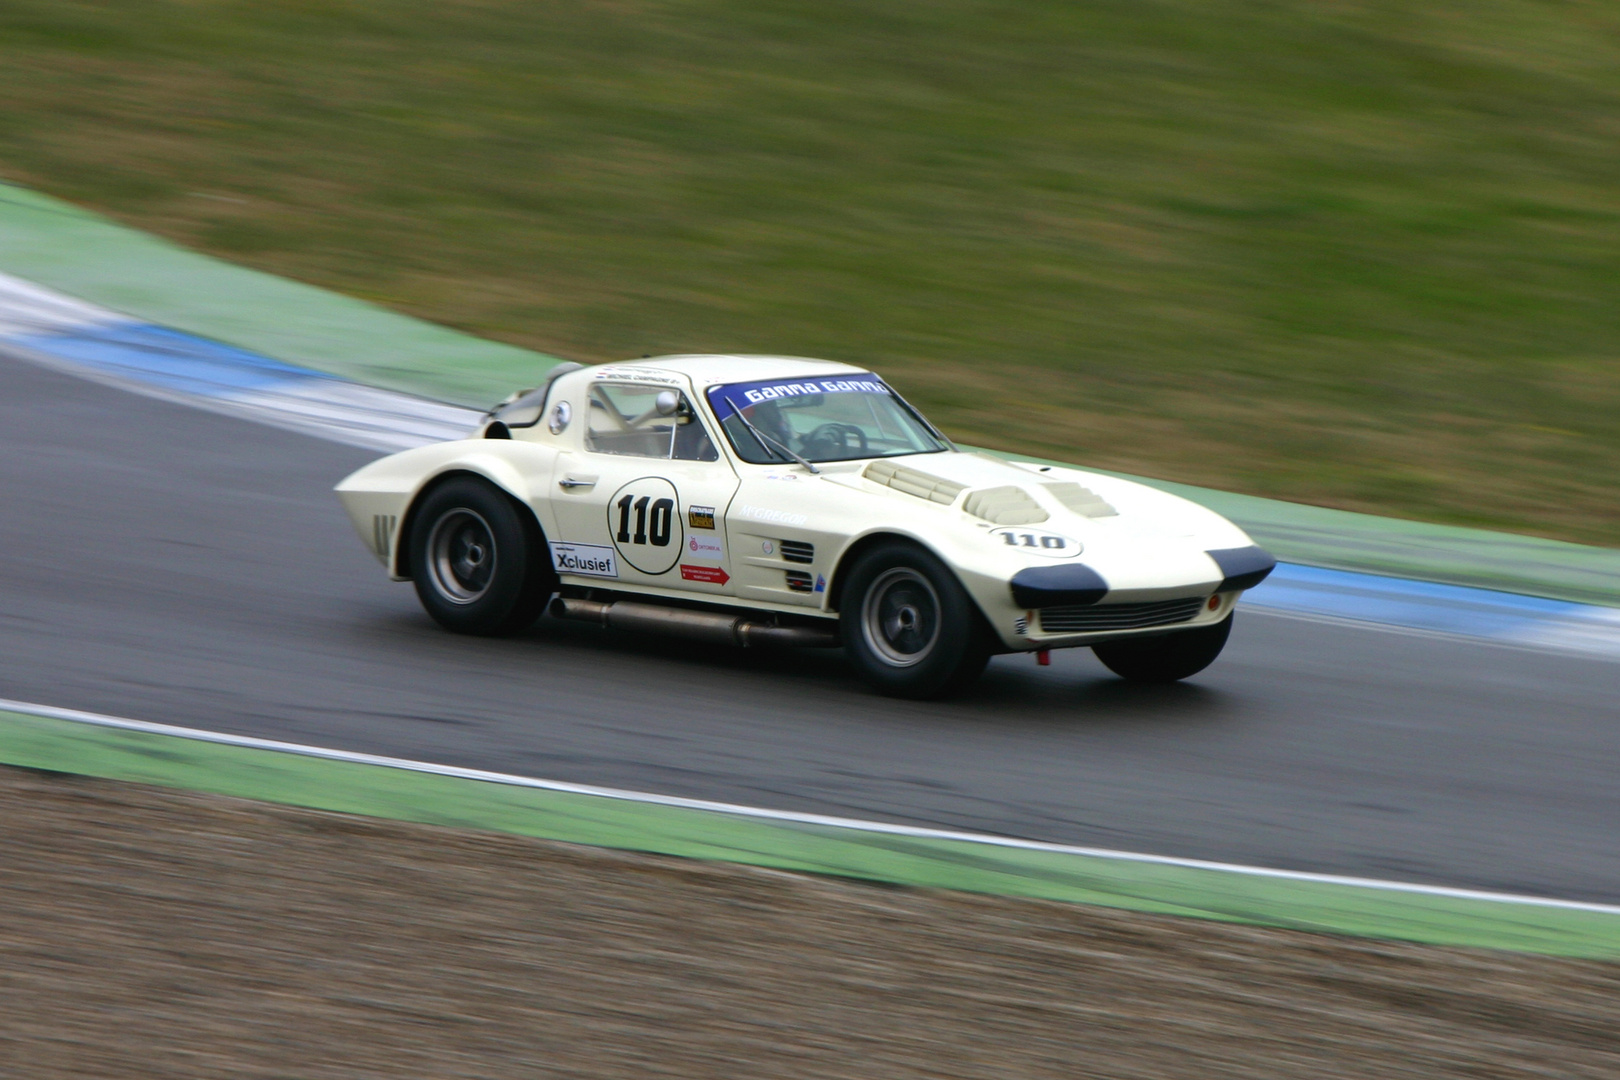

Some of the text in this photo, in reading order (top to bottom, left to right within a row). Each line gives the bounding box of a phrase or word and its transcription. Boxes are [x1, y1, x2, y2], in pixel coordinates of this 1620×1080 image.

[617, 494, 674, 547] 110
[999, 532, 1066, 549] 110
[556, 553, 611, 572] Xclusief
